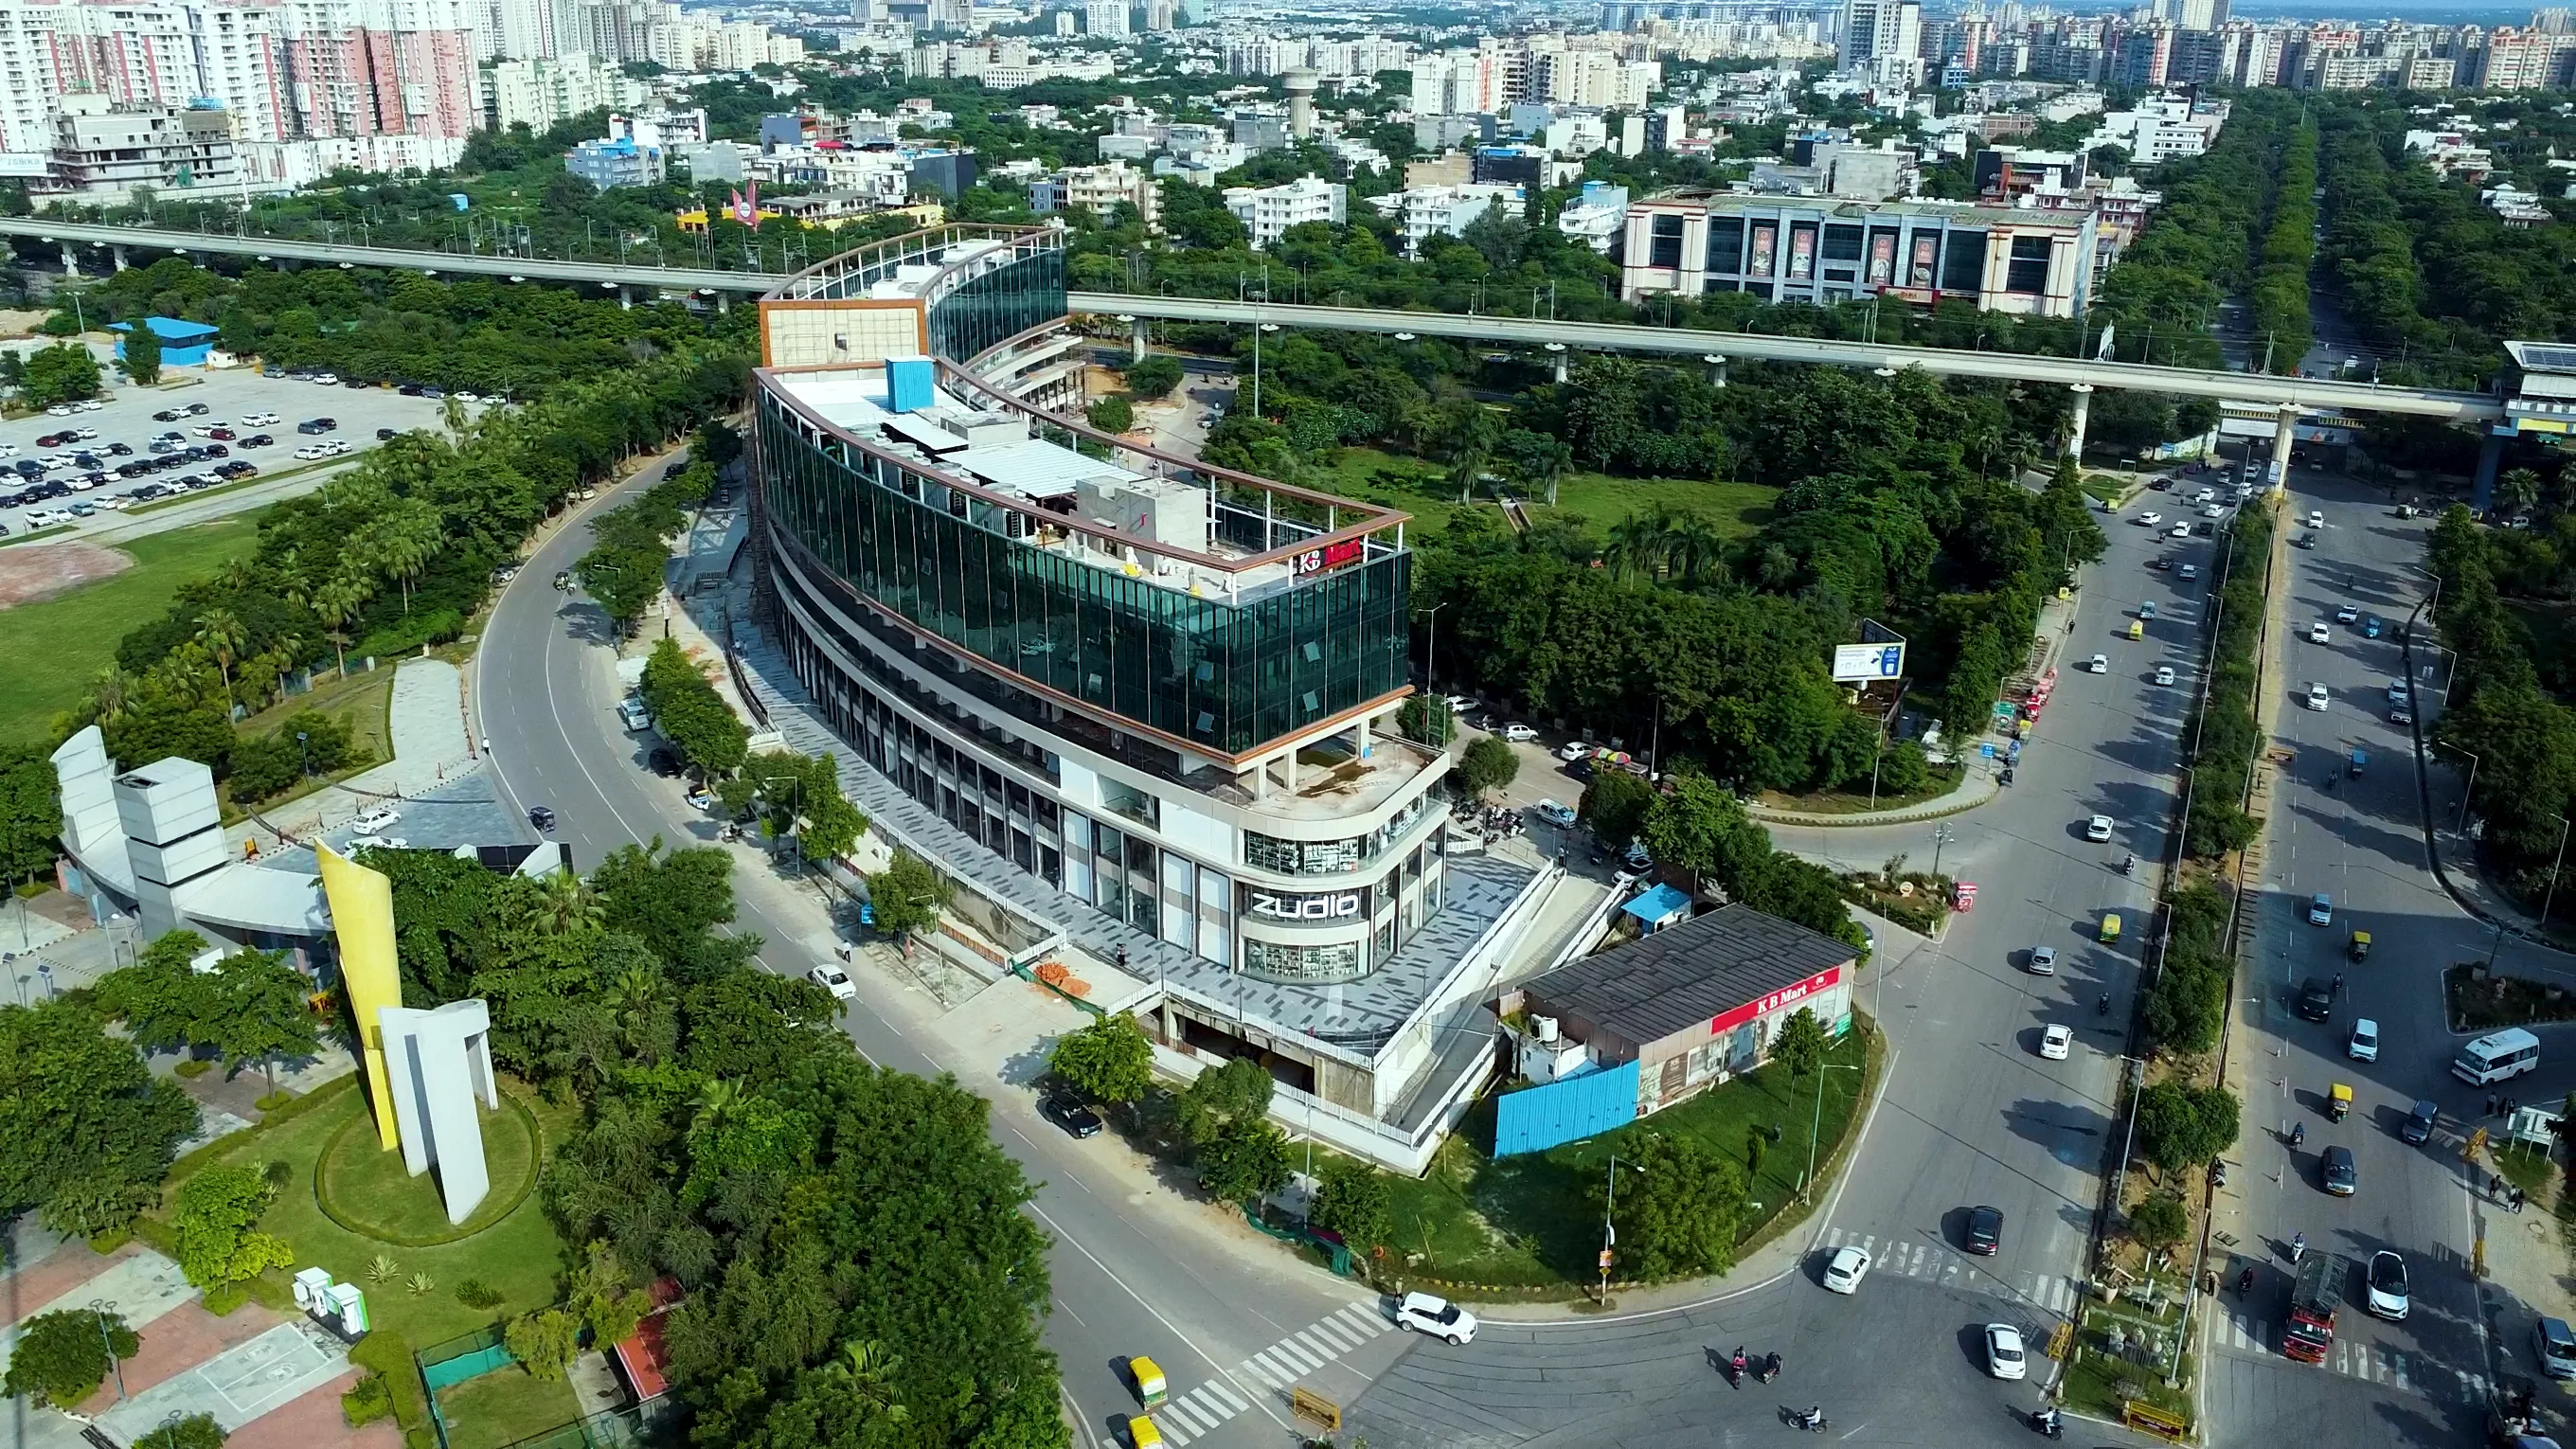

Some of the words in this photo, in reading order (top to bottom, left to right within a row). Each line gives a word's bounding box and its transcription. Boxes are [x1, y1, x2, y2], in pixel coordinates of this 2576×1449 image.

[1325, 537, 1362, 565] Mart
[1253, 892, 1359, 919] zudio
[1757, 998, 1768, 1014] K
[1769, 995, 1779, 1010] B
[1780, 984, 1807, 1005] Mart
